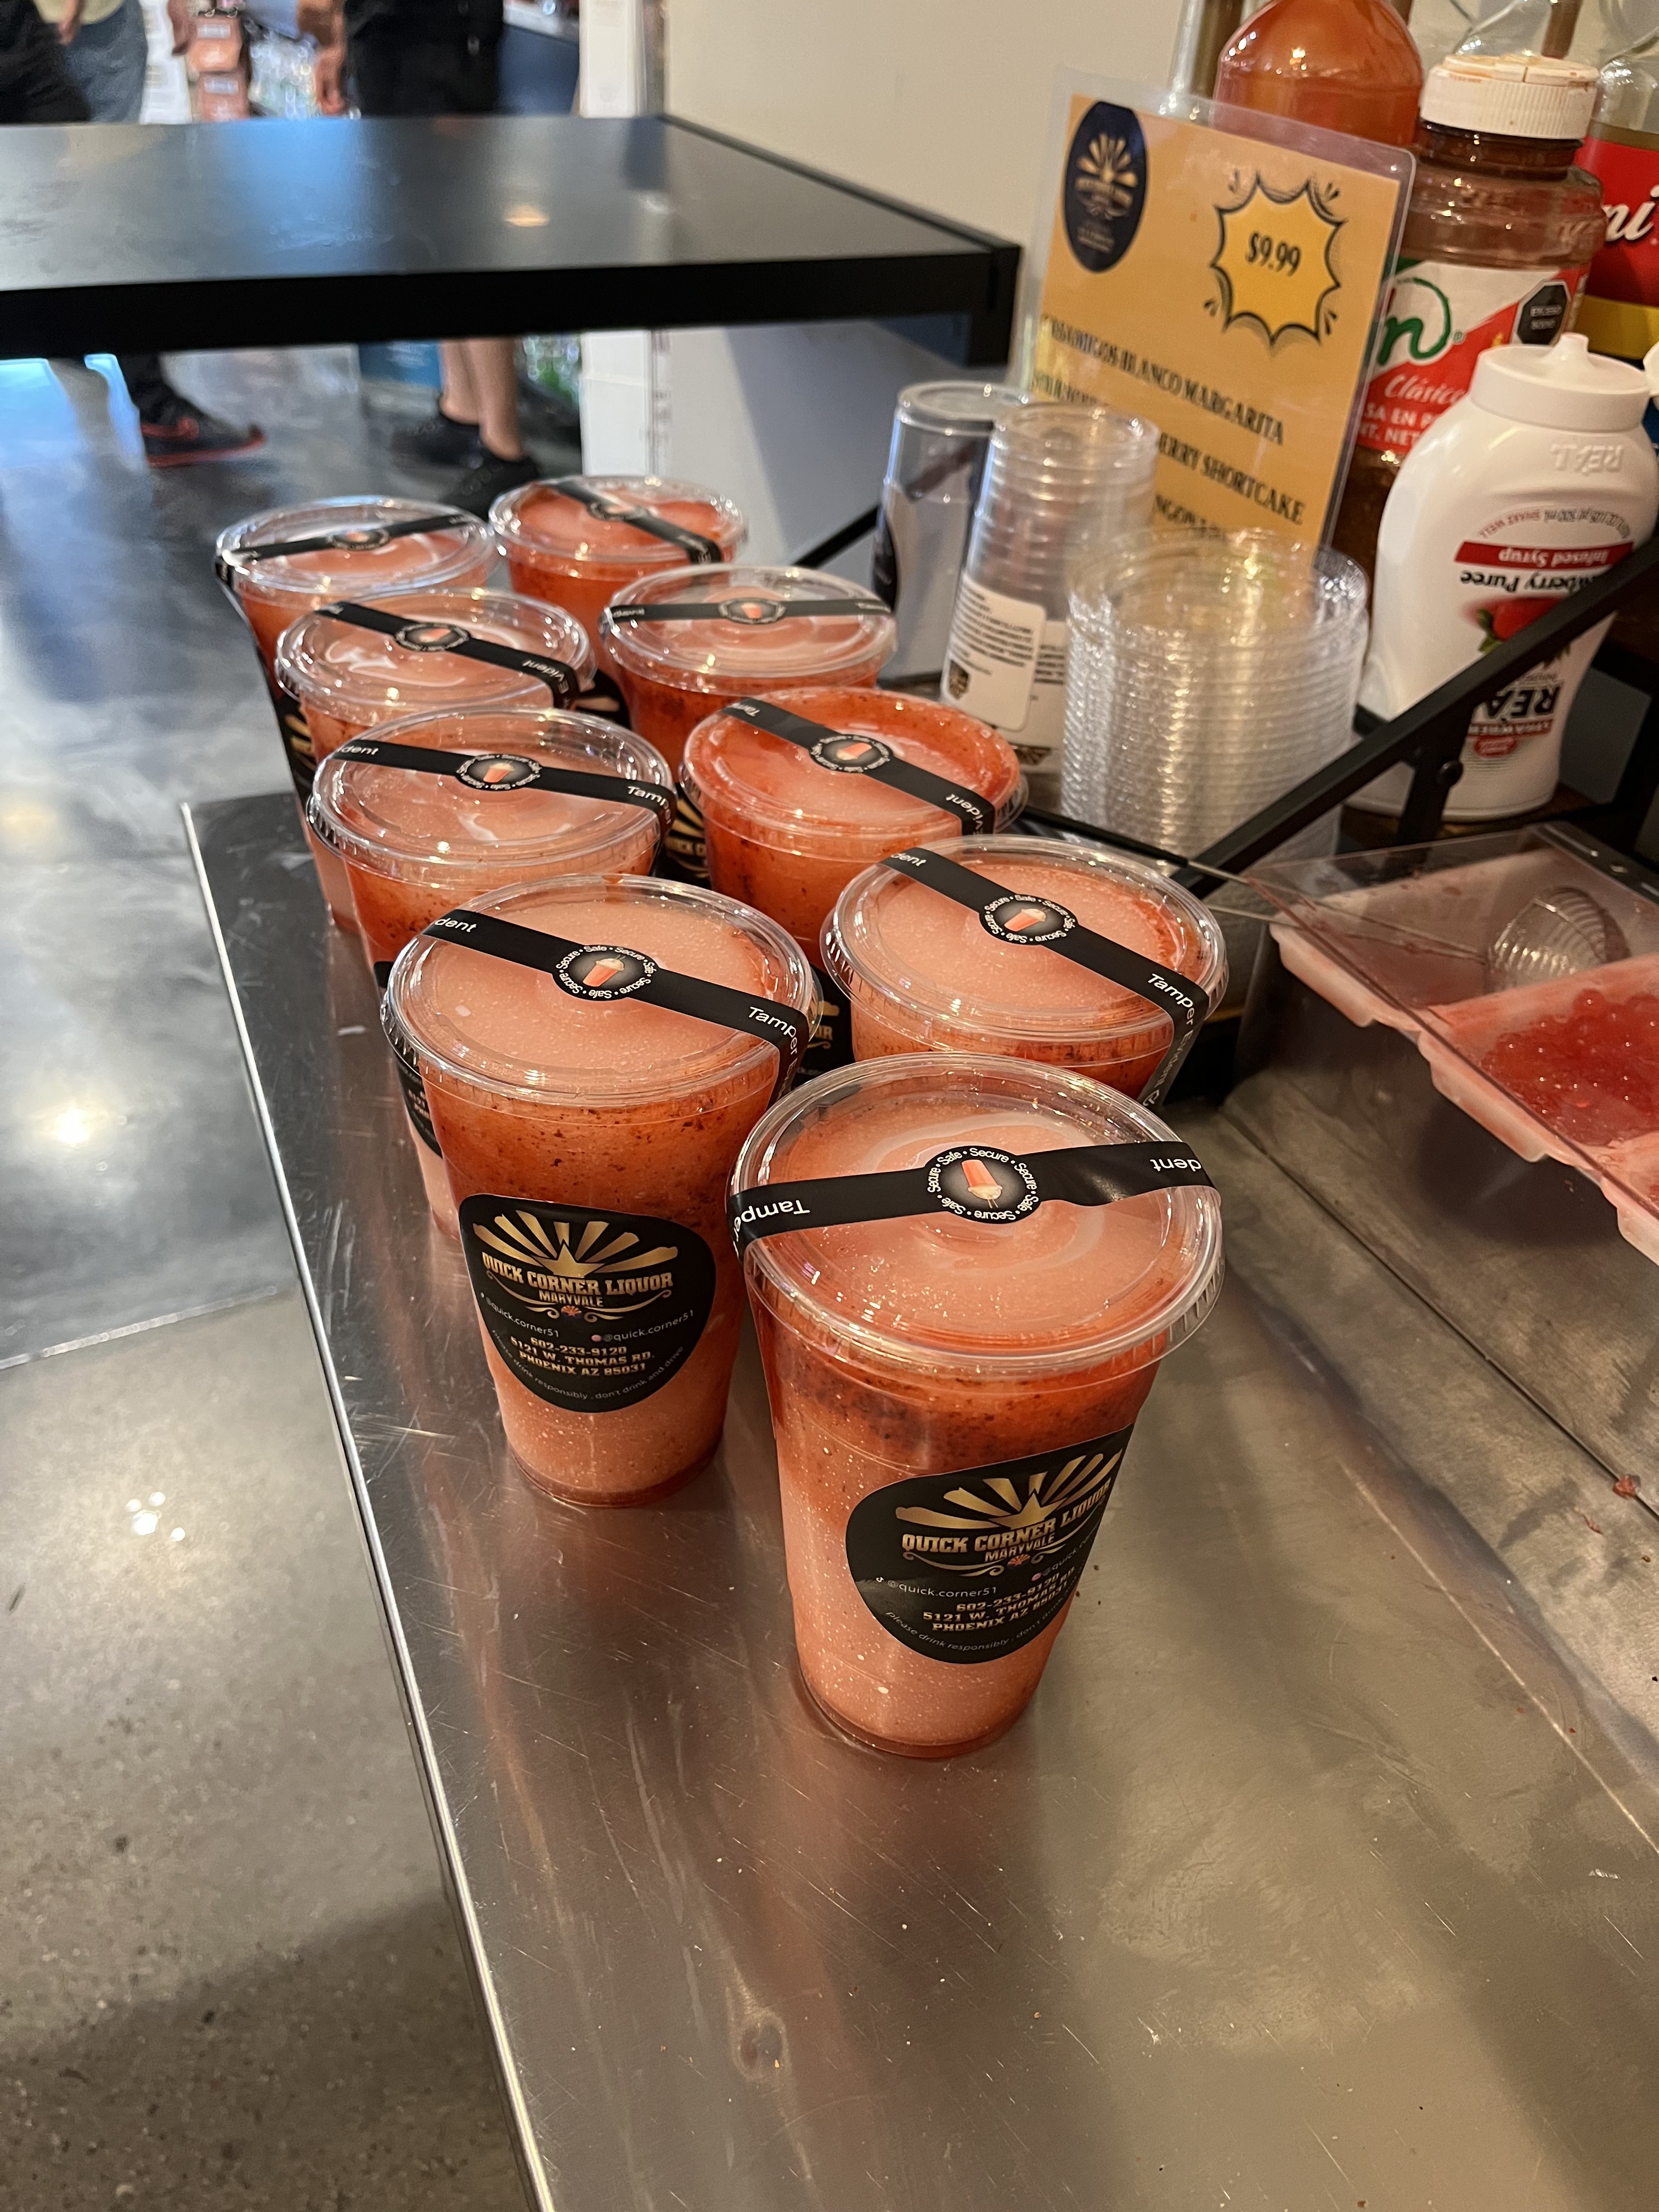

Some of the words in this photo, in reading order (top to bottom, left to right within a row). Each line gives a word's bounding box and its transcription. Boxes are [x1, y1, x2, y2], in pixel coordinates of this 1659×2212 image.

[1245, 232, 1300, 276] $9.99
[1201, 455, 1305, 525] SHORTCAKE
[1498, 547, 1549, 568] Syrup
[1460, 571, 1520, 592] Puree
[1487, 686, 1560, 716] REA
[556, 951, 580, 969] Secure
[559, 973, 583, 994] Secure
[588, 990, 612, 998] Safe
[619, 977, 651, 994] Secure
[1148, 973, 1195, 1025] Tamper
[748, 1006, 798, 1056] Tamper
[936, 1151, 963, 1165] Safe
[969, 1148, 1009, 1163] Secure
[927, 1167, 941, 1193] Secure
[1014, 1163, 1037, 1190] Secure
[941, 1197, 966, 1215] Safe
[974, 1210, 1016, 1220] Secure
[1017, 1194, 1039, 1211] Safe
[482, 1252, 524, 1284] QUICK
[527, 1271, 601, 1295] CORNER
[605, 1272, 674, 1296] LIQUOR
[539, 1290, 603, 1307] MARYVALE
[603, 1310, 694, 1342] @quick.corner51
[510, 1335, 538, 1356] 5121
[542, 1350, 561, 1363] W.
[564, 1356, 627, 1367] THOMAS
[631, 1351, 655, 1363] RD.
[530, 1336, 627, 1356] 602-233-9120
[518, 1350, 577, 1375] PHOENIX
[580, 1368, 600, 1376] AZ
[603, 1363, 646, 1376] 85031
[535, 1378, 588, 1400] responsibly
[595, 1390, 622, 1399] don't
[622, 1379, 647, 1393] drink
[648, 1366, 665, 1381] and
[664, 1346, 684, 1367] drive
[902, 1533, 968, 1553] QUICK
[974, 1517, 1057, 1551] CORNER
[985, 1532, 1056, 1562] MARYVALE
[887, 1579, 997, 1598] @quick.corner51
[923, 1611, 961, 1622] 5121
[969, 1611, 990, 1621] W.
[996, 1582, 1057, 1616] THOMAS
[932, 1616, 1005, 1632] PHOENIX
[1008, 1607, 1029, 1622] AZ
[918, 1633, 946, 1647] drink
[947, 1638, 1009, 1651] responsibly
